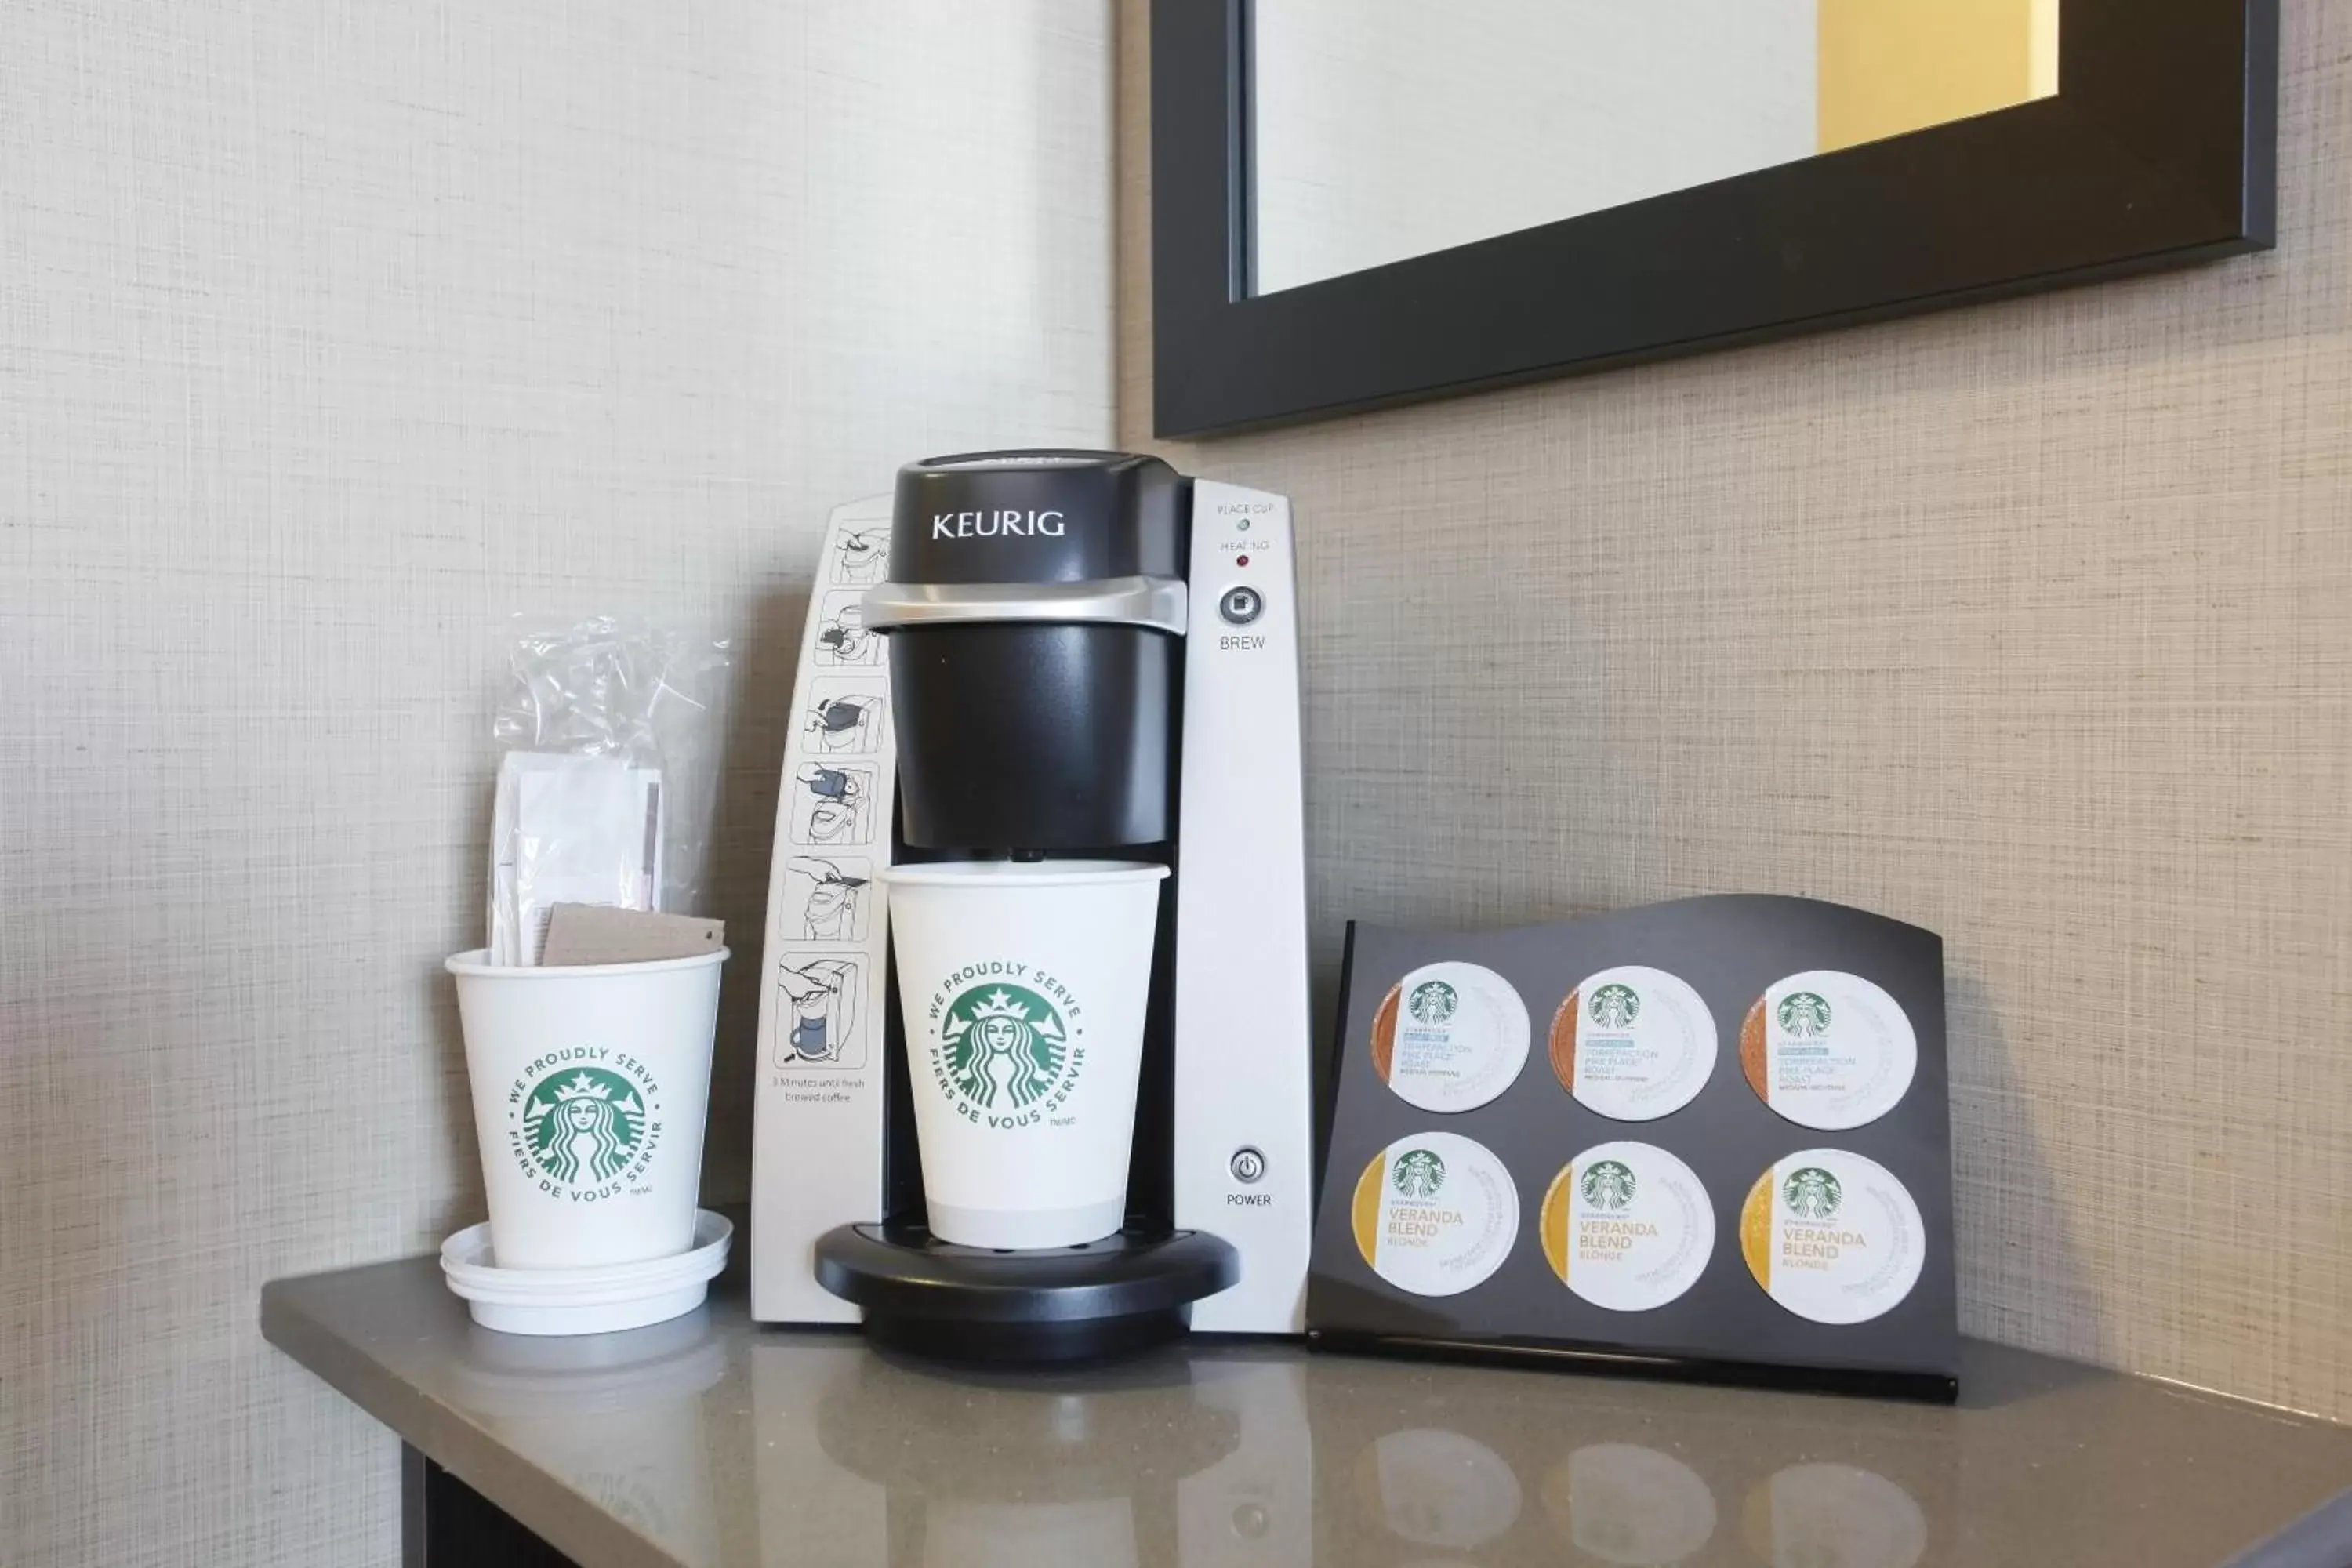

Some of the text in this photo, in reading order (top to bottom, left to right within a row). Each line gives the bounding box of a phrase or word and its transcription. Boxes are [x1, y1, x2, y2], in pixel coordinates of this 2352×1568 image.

[1218, 503, 1274, 514] PLACE CUP
[931, 510, 1065, 540] KEURIG
[1220, 540, 1270, 551] HEATING
[1220, 636, 1265, 650] BREW
[929, 961, 1081, 1019] WE PROUDLY SERVE
[509, 1047, 658, 1104] WE PROUDLY SERVE
[780, 1077, 817, 1087] Minutes
[929, 1047, 1085, 1130] FIERS DE VOUS SERVIR
[509, 1121, 662, 1202] FIERS DE VOUS SERVIR
[1227, 1194, 1271, 1206] POWER
[1389, 1207, 1464, 1225] VERANDA
[1388, 1221, 1439, 1236] BLEND
[1580, 1221, 1658, 1236] VERANDA
[1580, 1235, 1632, 1249] BLEND
[1783, 1228, 1867, 1247] VERANDA
[1783, 1243, 1838, 1259] BLEND
